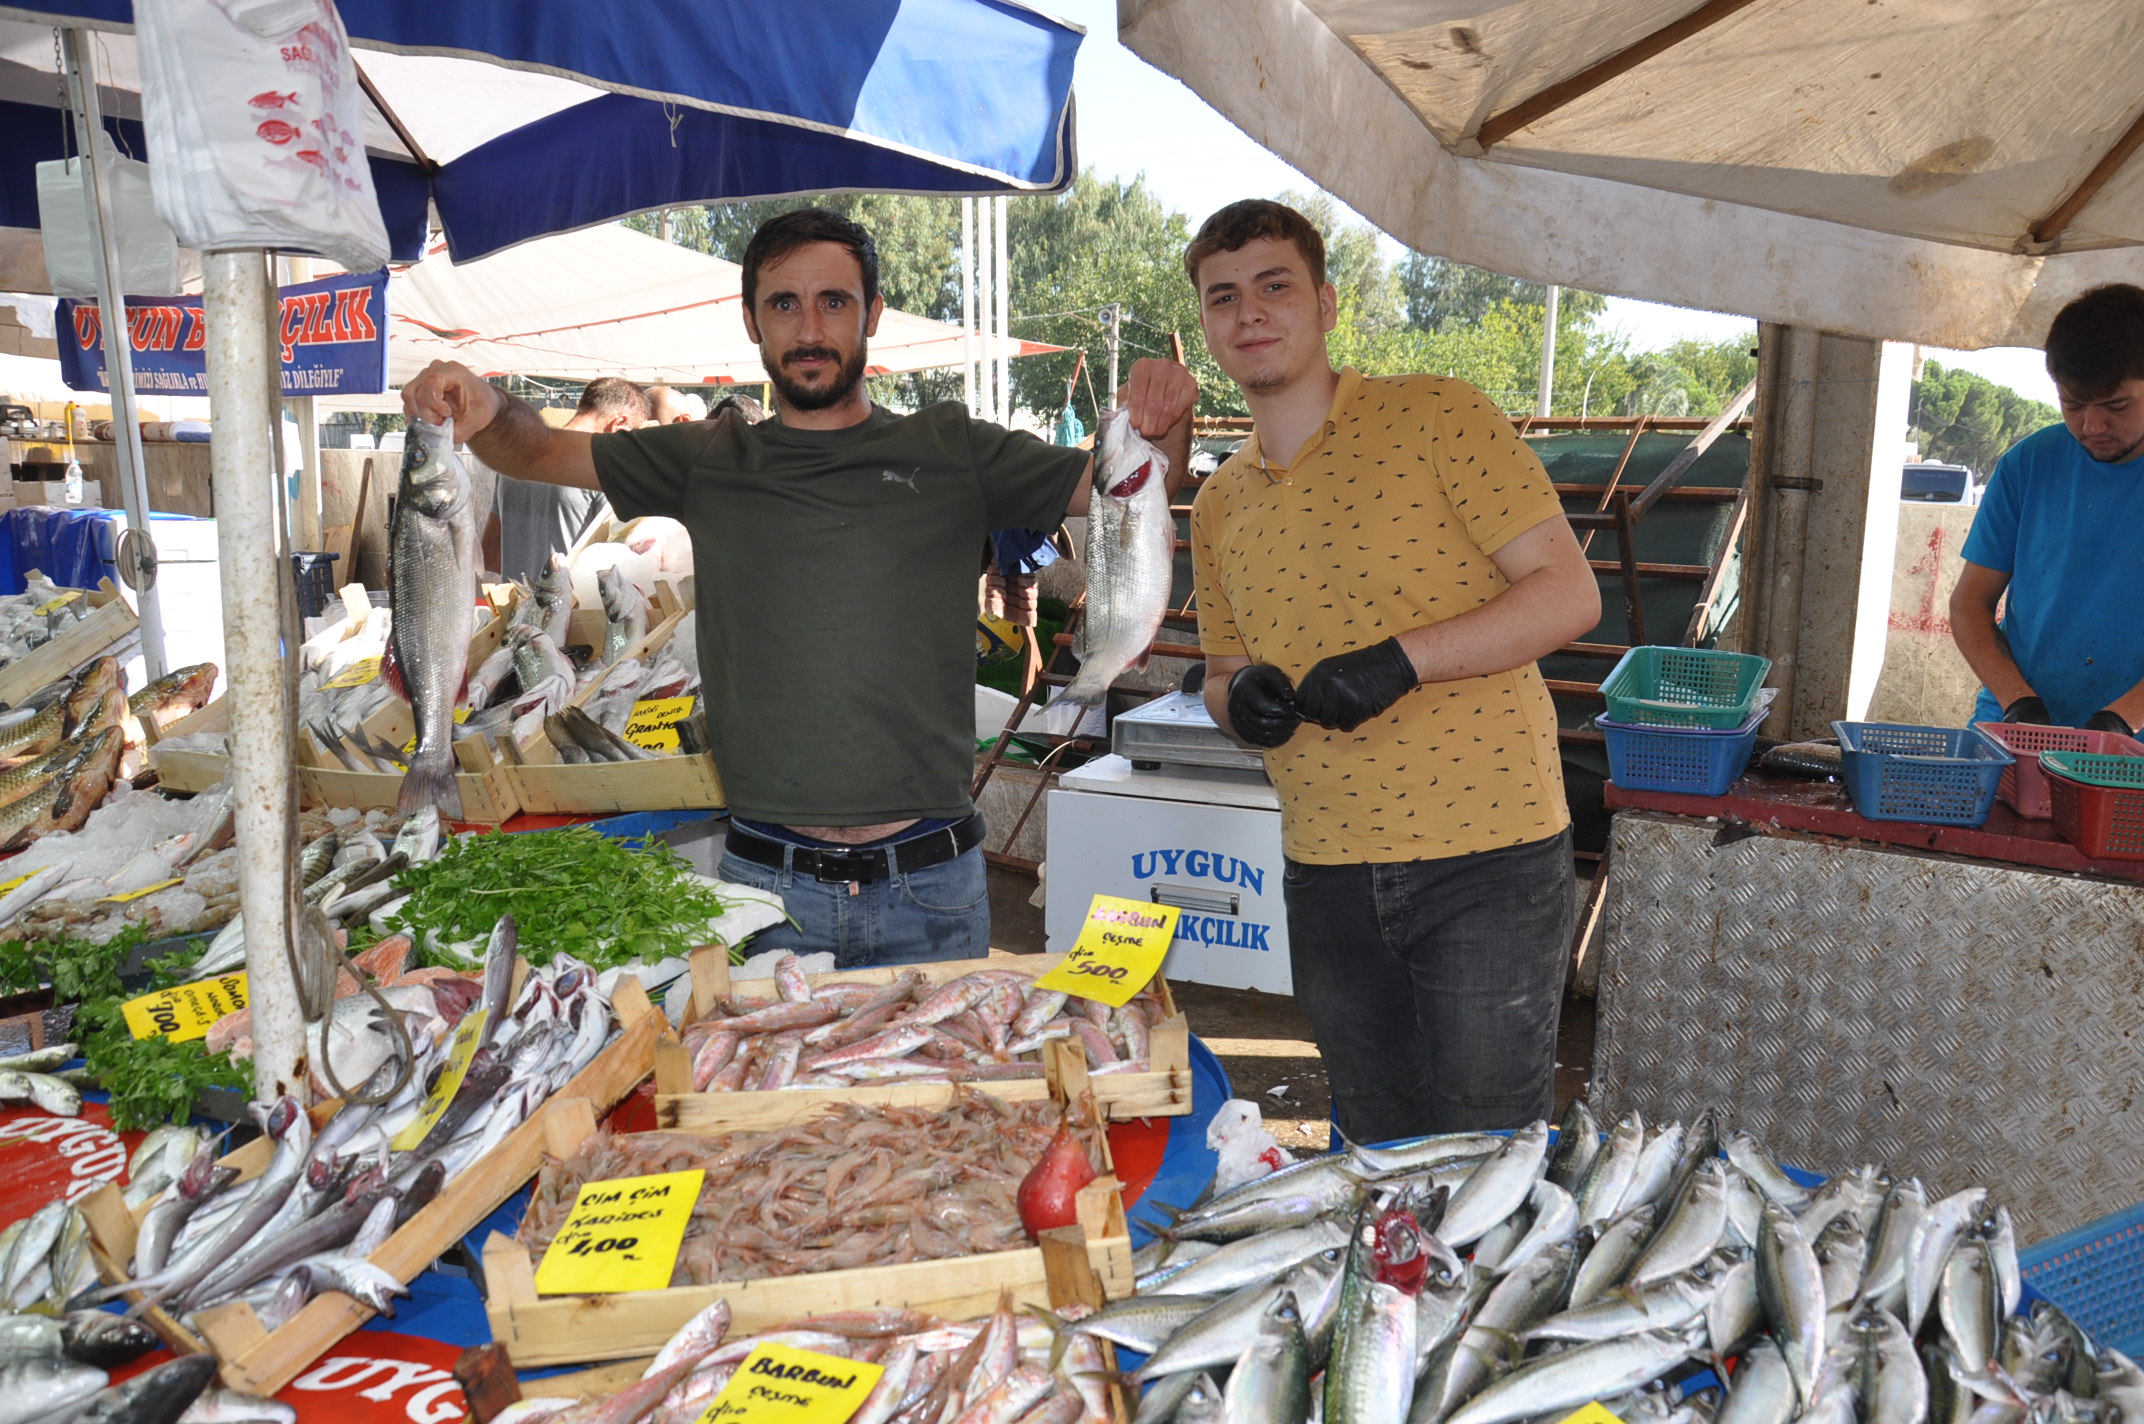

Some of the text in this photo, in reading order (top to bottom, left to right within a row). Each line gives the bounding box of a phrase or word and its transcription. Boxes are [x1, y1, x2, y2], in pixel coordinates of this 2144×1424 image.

[1132, 849, 1265, 896] UYGUN
[1172, 914, 1271, 951] IKÇILIK
[1067, 961, 1128, 979] 500
[146, 1001, 180, 1033] 700
[292, 1356, 466, 1424] UYG
[750, 1357, 857, 1389] BARBUN
